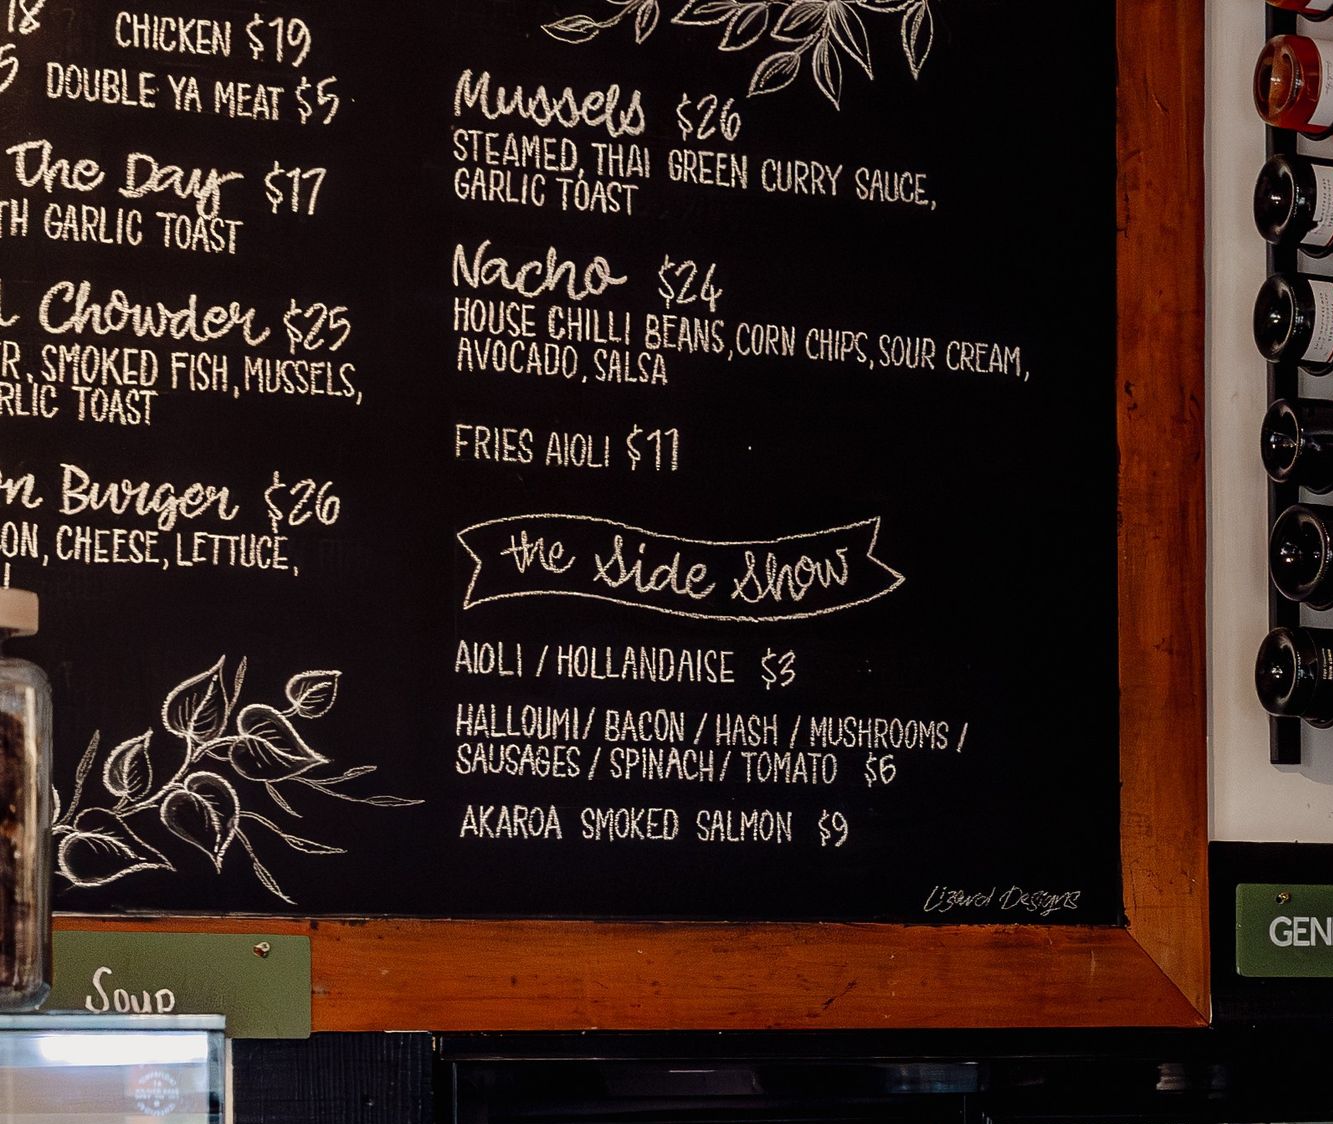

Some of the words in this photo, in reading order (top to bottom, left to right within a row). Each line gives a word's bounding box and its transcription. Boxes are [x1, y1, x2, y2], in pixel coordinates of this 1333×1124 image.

[116, 12, 231, 56] CHICKEN
[246, 14, 311, 67] $19
[47, 62, 155, 108] DOUBLE
[168, 75, 202, 112] YA
[215, 81, 284, 120] MEAT
[296, 76, 339, 124] $5
[454, 69, 645, 139] Mussels
[676, 93, 741, 141] $26
[6, 139, 105, 193] The
[118, 152, 244, 221] Day
[264, 161, 326, 215] $17
[454, 129, 584, 179] STEAMED,
[593, 143, 650, 177] THAI
[668, 149, 747, 189] GREEN
[762, 159, 842, 195] CURRY
[855, 167, 936, 210] SAUCE,
[455, 167, 545, 206] GARLIC
[556, 177, 639, 215] TOAST
[44, 206, 142, 245] GARLIC
[156, 210, 243, 254] TOAST
[453, 240, 627, 300] Nacho
[658, 255, 722, 312] $24
[39, 280, 270, 346] Chowder
[283, 299, 351, 353] $25
[454, 297, 536, 337] HOUSE
[548, 305, 630, 345] CHILLI
[645, 314, 732, 362] BEANS,
[736, 323, 795, 356] CORN
[806, 328, 873, 369] CHIPS,
[880, 335, 935, 369] SOUR
[947, 341, 1029, 381] CREAM,
[41, 343, 158, 386] SMOKED
[171, 352, 239, 398] FISH,
[245, 359, 362, 405] MUSSELS,
[458, 337, 587, 383] AVOCADO,
[594, 349, 667, 385] SALSA
[76, 388, 158, 425] TOAST
[456, 424, 533, 463] FRIES
[546, 432, 609, 467] AIOLI
[627, 424, 678, 471] $11
[59, 464, 239, 531] Burger
[264, 471, 340, 533] $26
[56, 525, 170, 570] CHEESE,
[177, 532, 298, 576] LETTUCE,
[455, 640, 522, 677] AIOLI
[558, 645, 734, 683] HOLLANDAISE
[762, 648, 795, 690] $3
[605, 709, 684, 742] BACON
[716, 715, 777, 746] HASH
[810, 717, 948, 749] MUSHROOMS
[456, 744, 580, 777] SAUSAGES
[741, 751, 837, 784] TOMATO
[864, 754, 896, 787] $6
[460, 805, 562, 839] AKAROA
[581, 808, 678, 841] SMOKED
[697, 810, 792, 843] SALMON
[818, 810, 848, 847] $9
